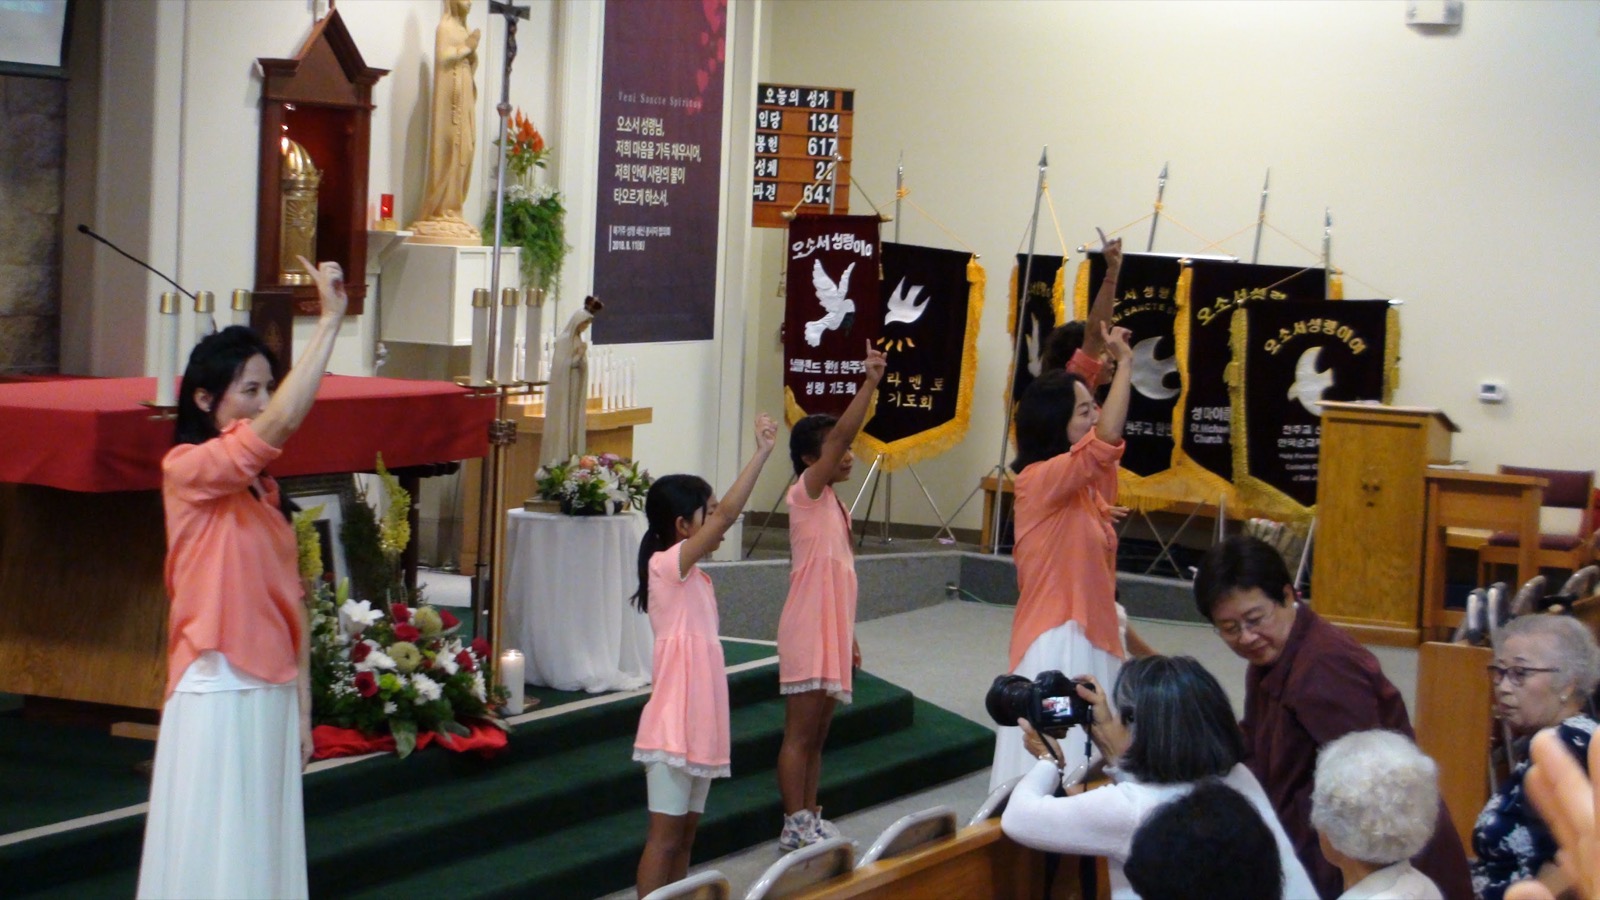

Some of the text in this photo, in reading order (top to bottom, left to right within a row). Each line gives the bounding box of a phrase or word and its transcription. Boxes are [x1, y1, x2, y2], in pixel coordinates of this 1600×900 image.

[764, 88, 829, 108] 오늘의 성가
[616, 115, 640, 134] 오소서
[758, 110, 839, 132] 입당 134
[615, 139, 632, 159] 저희
[632, 140, 655, 160] 마음을
[655, 142, 671, 161] 가득
[755, 135, 838, 156] 봉헌 617
[614, 163, 686, 185] 저희 안에 사랑의 불이
[754, 158, 778, 177] 성체
[613, 187, 644, 207] 타오르게
[752, 182, 776, 201] 파견
[791, 234, 830, 260] 오소서
[829, 381, 857, 396] 기도회
[887, 391, 933, 411] 기도회
